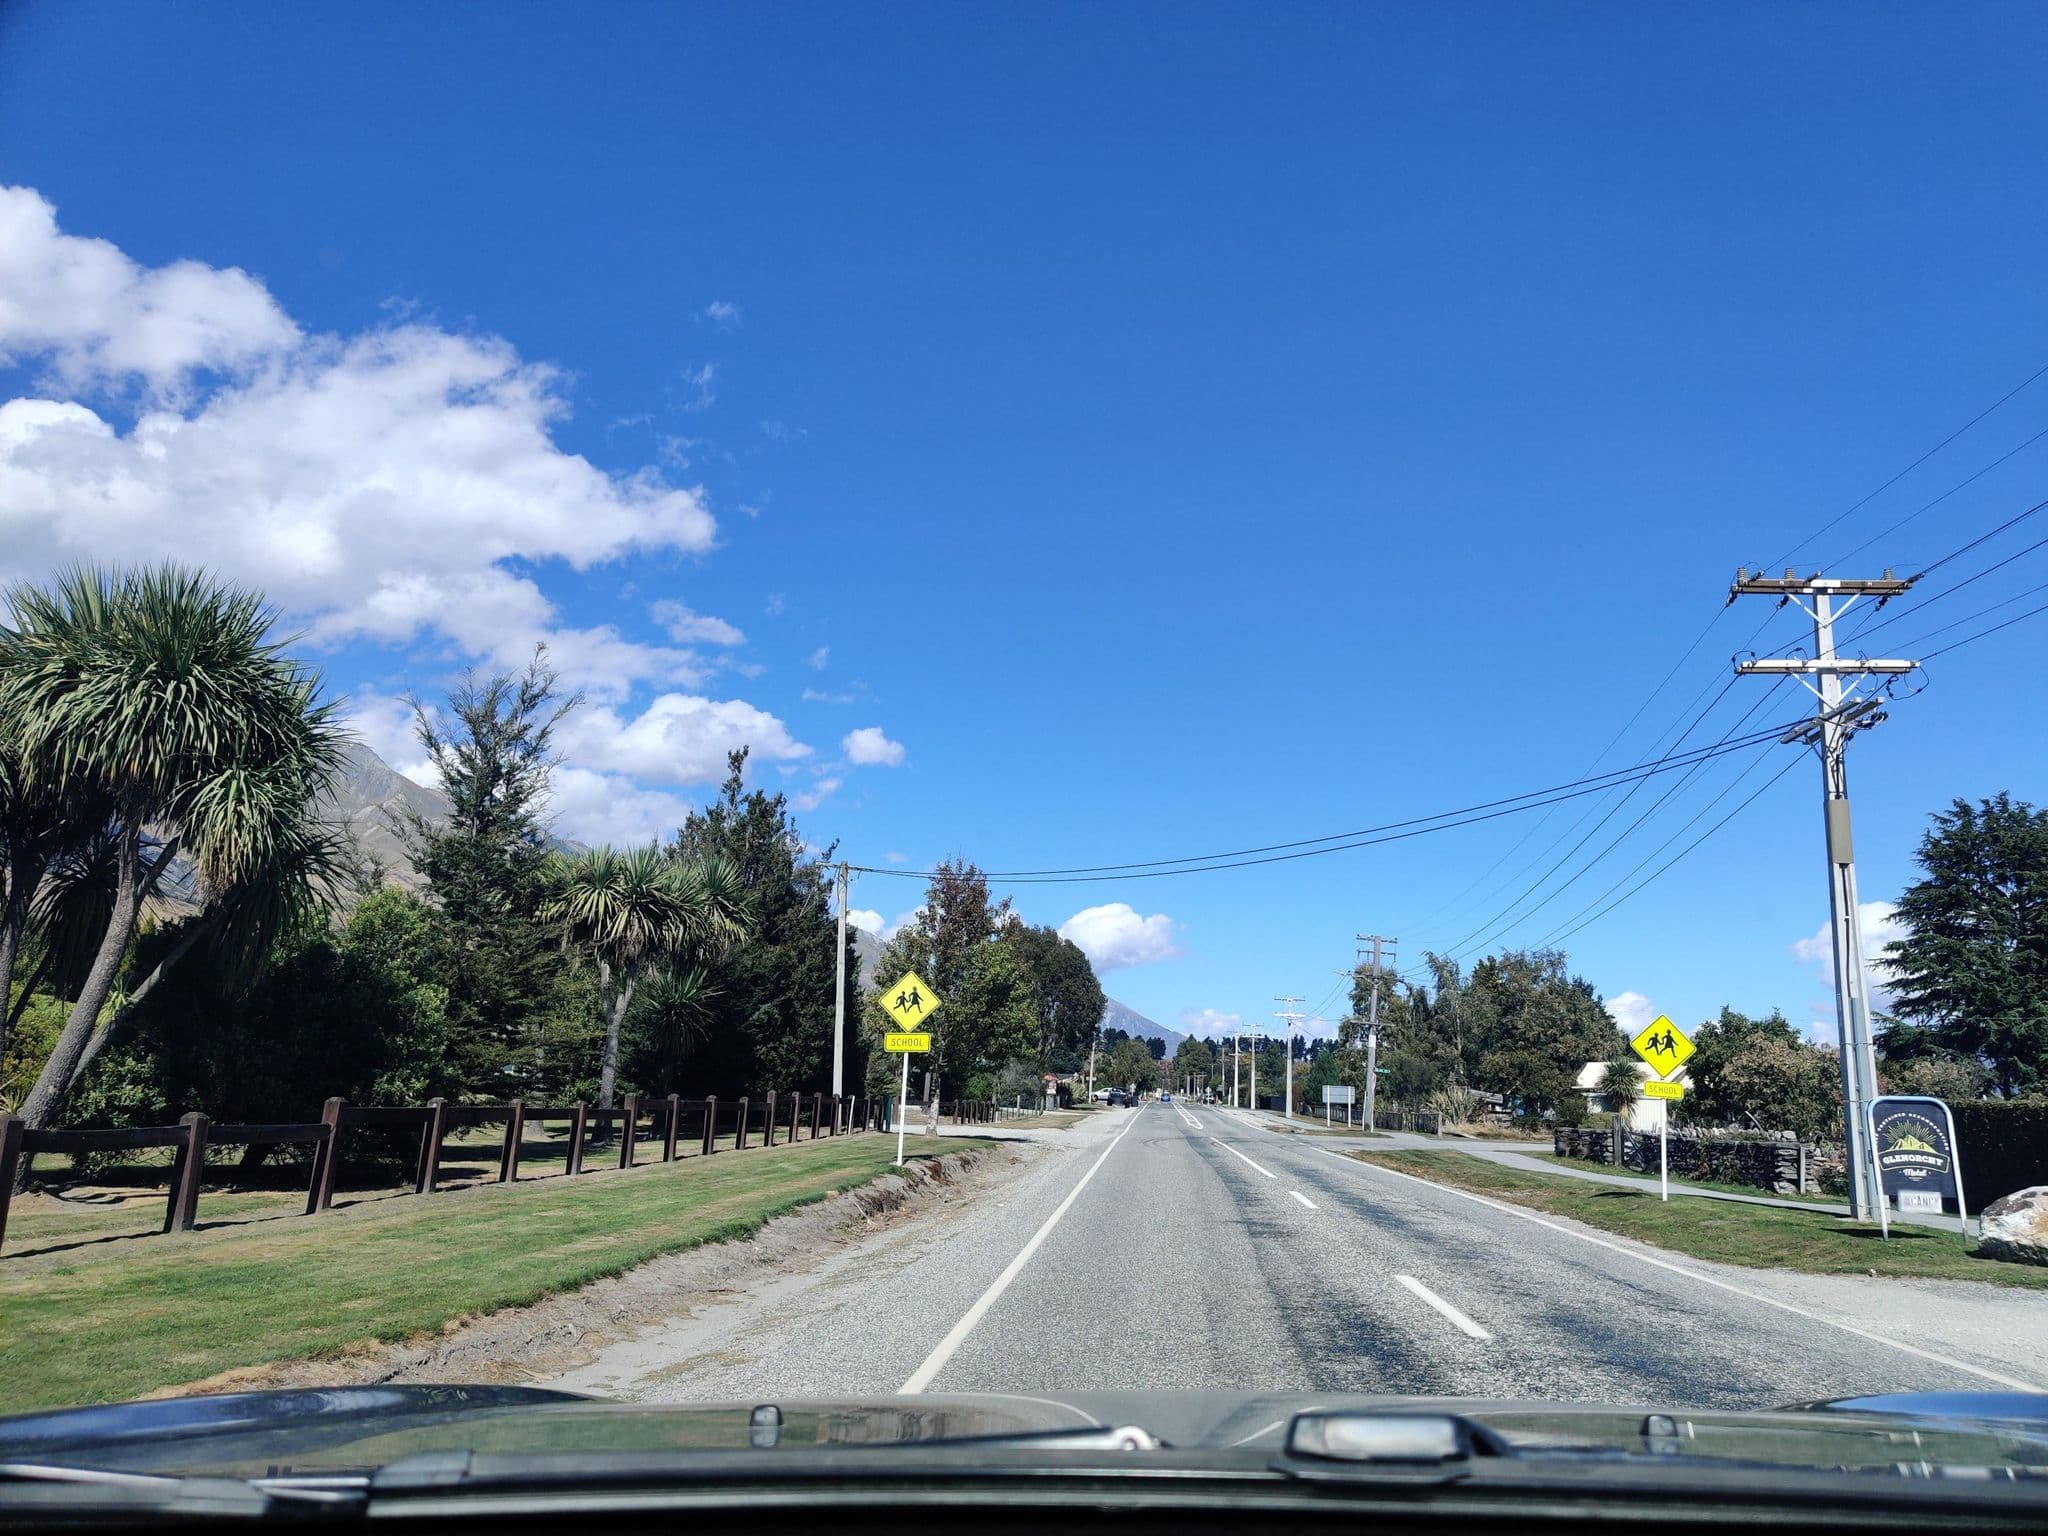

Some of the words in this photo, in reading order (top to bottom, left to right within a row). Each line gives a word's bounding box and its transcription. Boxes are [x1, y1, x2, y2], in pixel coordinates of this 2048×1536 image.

[891, 1038, 924, 1047] SCHOOL
[1649, 1085, 1678, 1095] SCHOOL
[1882, 1154, 1944, 1166] GLENORCHY
